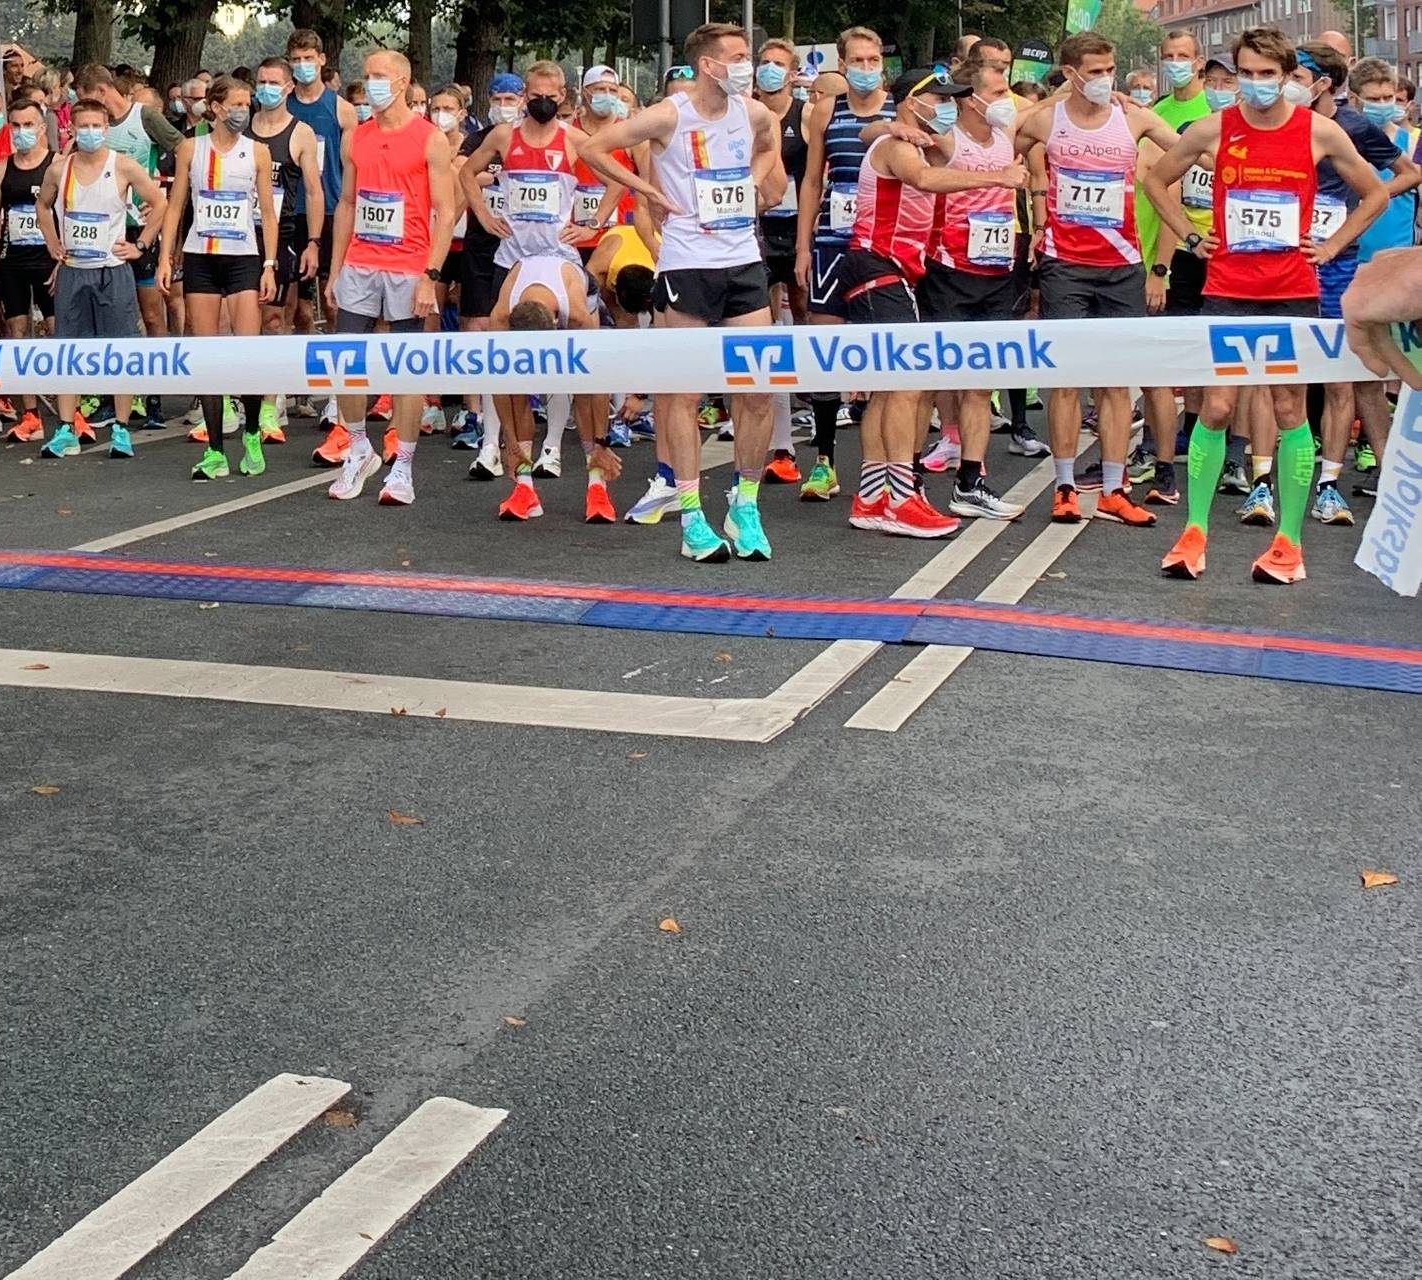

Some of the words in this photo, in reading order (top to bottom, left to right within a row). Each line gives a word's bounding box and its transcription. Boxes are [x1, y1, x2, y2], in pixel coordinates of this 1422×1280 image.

[1060, 145, 1079, 157] LG
[1082, 144, 1123, 157] Alpen
[519, 188, 547, 201] 709
[712, 186, 744, 205] 676
[1071, 186, 1106, 203] 717
[205, 205, 241, 219] 1037
[362, 206, 395, 222] 1507
[1241, 209, 1282, 227] 575
[73, 226, 98, 239] 288
[984, 228, 1010, 244] 713
[13, 342, 191, 378] Volksbank
[380, 337, 590, 377] Volksbank
[809, 327, 1057, 373] Volksbank
